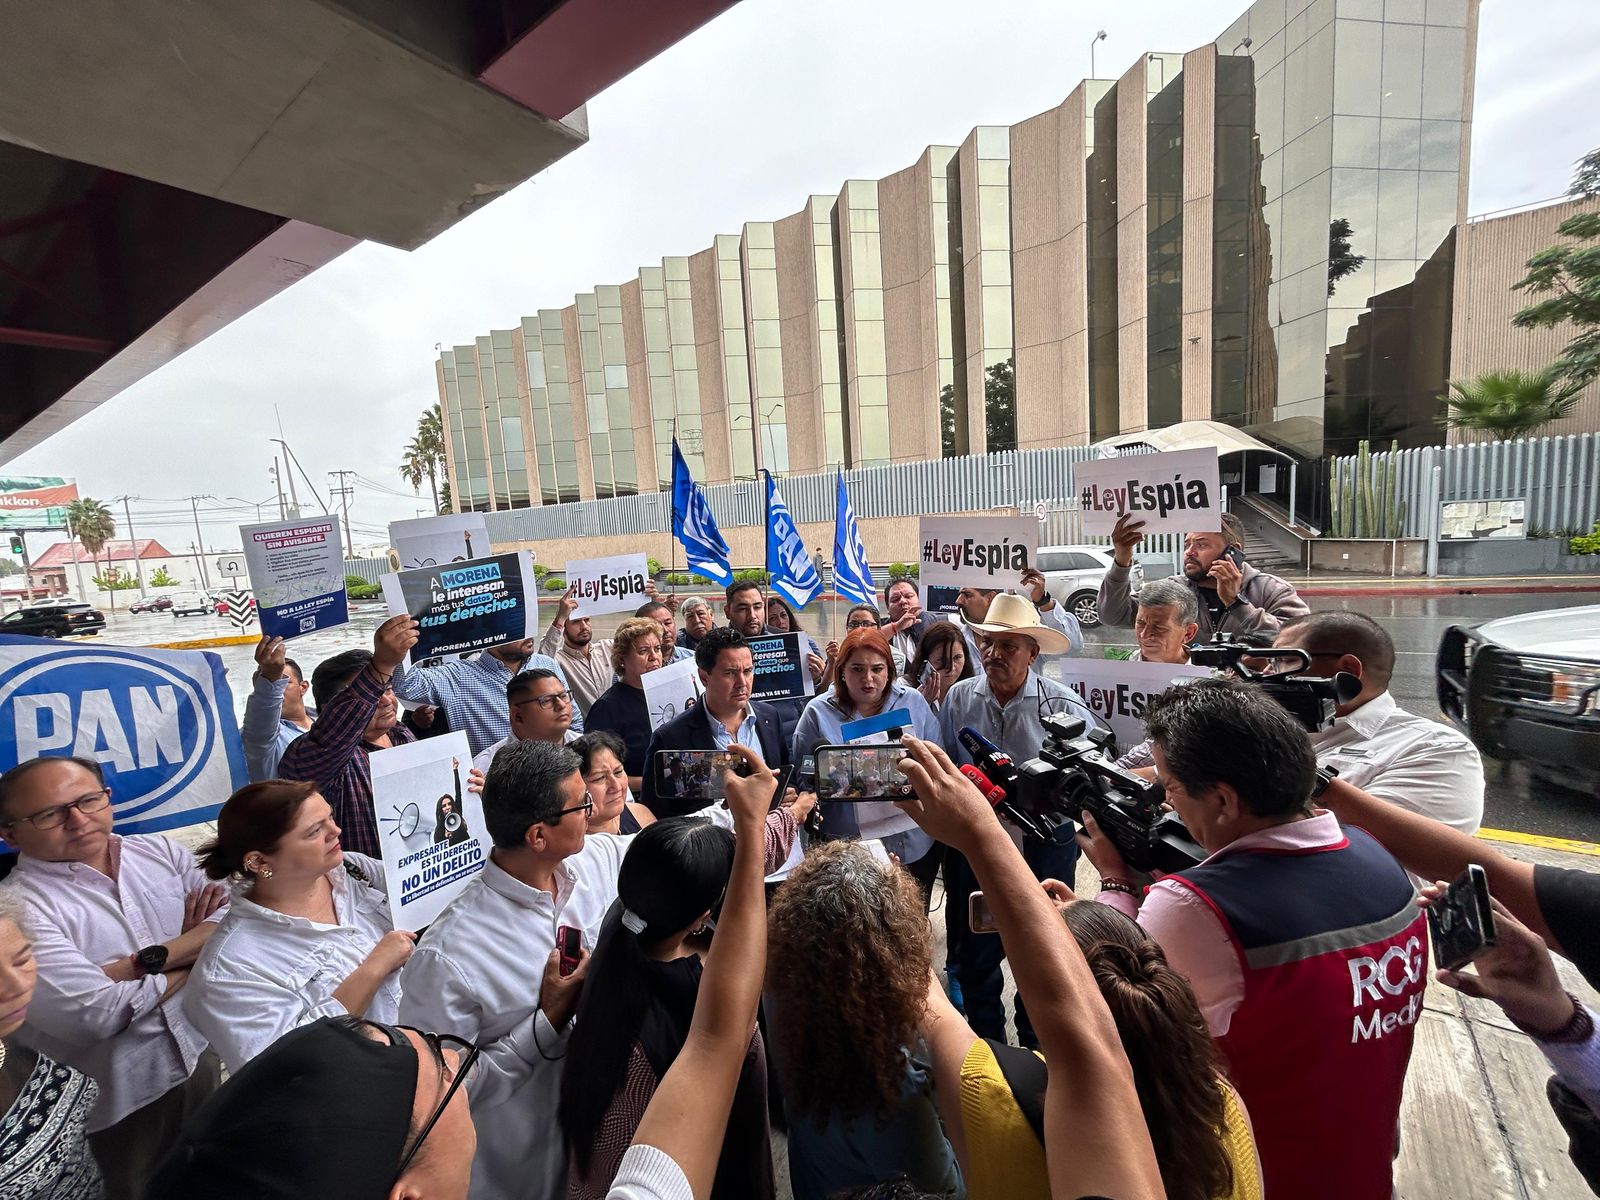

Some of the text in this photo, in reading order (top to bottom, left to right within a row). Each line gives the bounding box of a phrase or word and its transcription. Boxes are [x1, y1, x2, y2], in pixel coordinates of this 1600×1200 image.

[1081, 474, 1210, 518] #LeyEspía
[255, 525, 331, 541] QUIEREN ESPIARTE
[267, 541, 282, 549] SIN
[774, 515, 812, 582] PAN
[923, 537, 1028, 575] #LeyEspía
[430, 566, 499, 590] A MORENA
[432, 580, 505, 603] le interesan
[570, 570, 645, 601] #LeyEspía
[277, 608, 288, 616] NO
[420, 596, 517, 628] tus derechos
[431, 589, 509, 614] más tus datos que
[431, 633, 507, 654] ¡MORENA YA SE VA!
[753, 651, 786, 660] teresan
[13, 685, 184, 773] PAN
[398, 841, 449, 869] EXPRESARTE
[421, 838, 480, 870] ES TU DERECHO,
[401, 847, 482, 894] NO UN DELITO
[411, 886, 430, 900] libertad
[1348, 936, 1423, 1008] RCG
